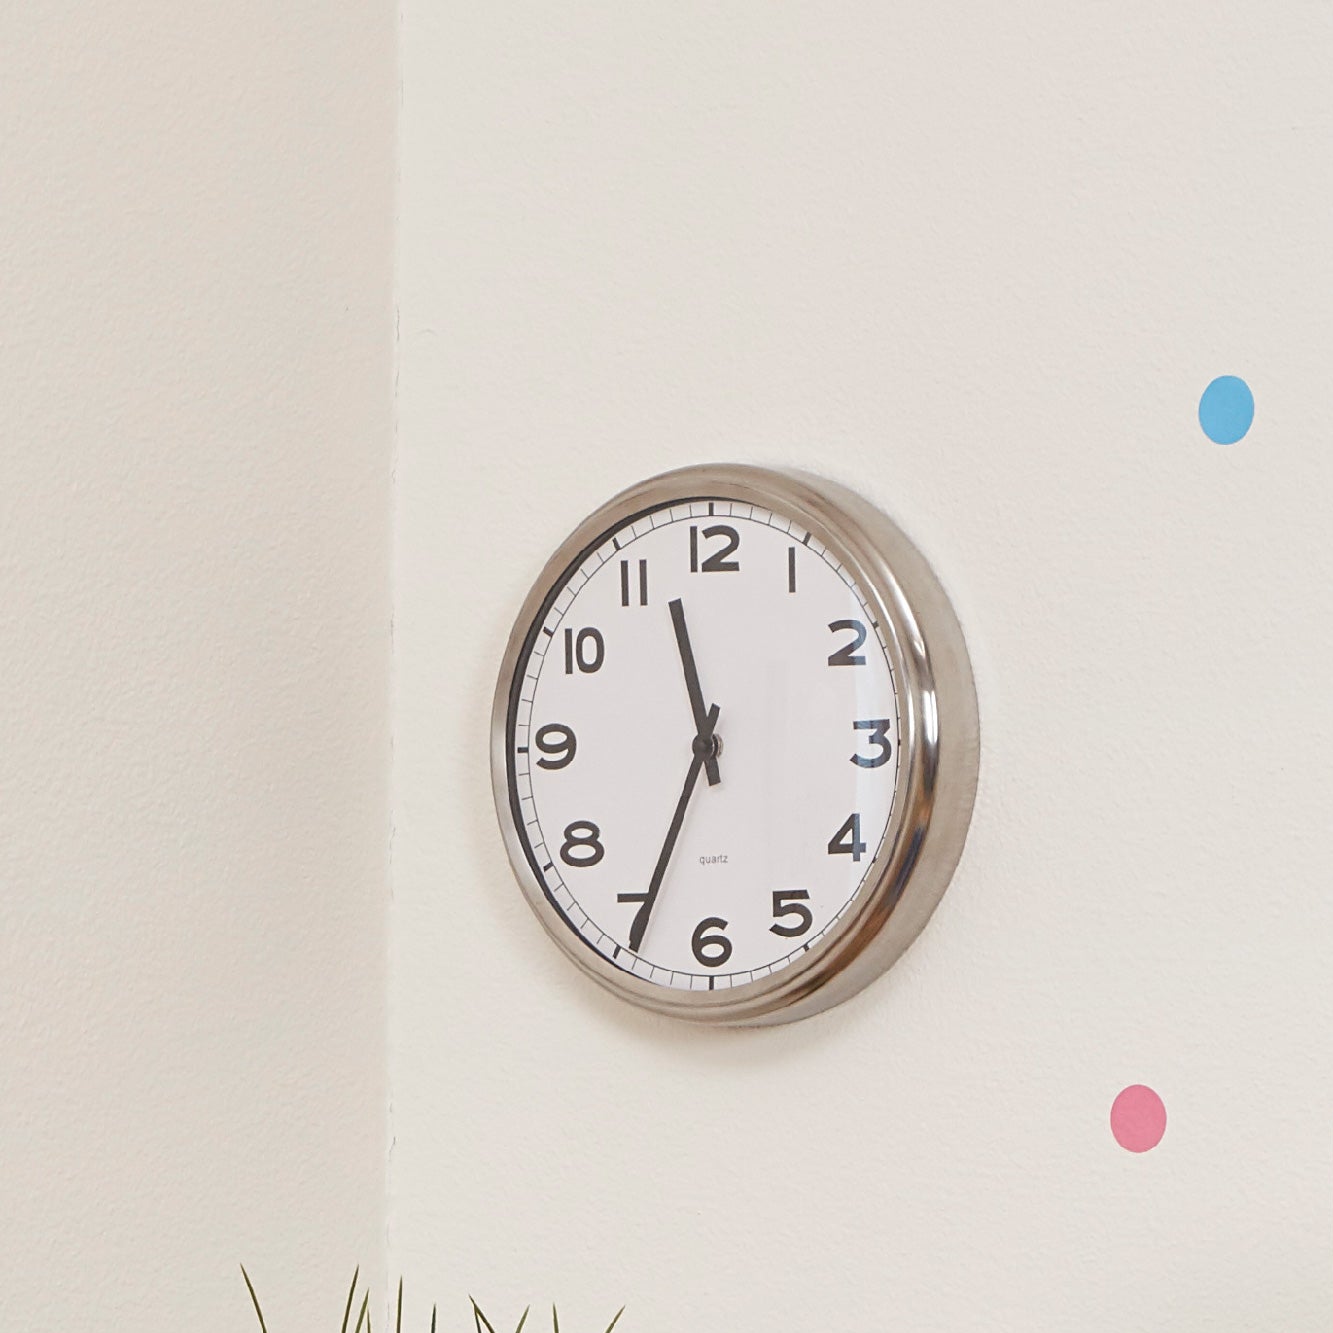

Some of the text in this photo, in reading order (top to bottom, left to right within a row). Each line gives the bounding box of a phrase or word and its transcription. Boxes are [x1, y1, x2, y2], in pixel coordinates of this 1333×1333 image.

[690, 525, 740, 572] 12
[787, 546, 796, 594] 1
[620, 559, 648, 606] 11
[564, 626, 605, 675] 10
[827, 620, 868, 667] 2
[535, 723, 577, 770] 9
[849, 719, 893, 769] 3
[560, 820, 605, 868] 8
[699, 854, 729, 866] quartz
[827, 813, 868, 863] 4
[616, 892, 652, 950] 7
[769, 889, 813, 938] 5
[691, 917, 733, 968] 6
